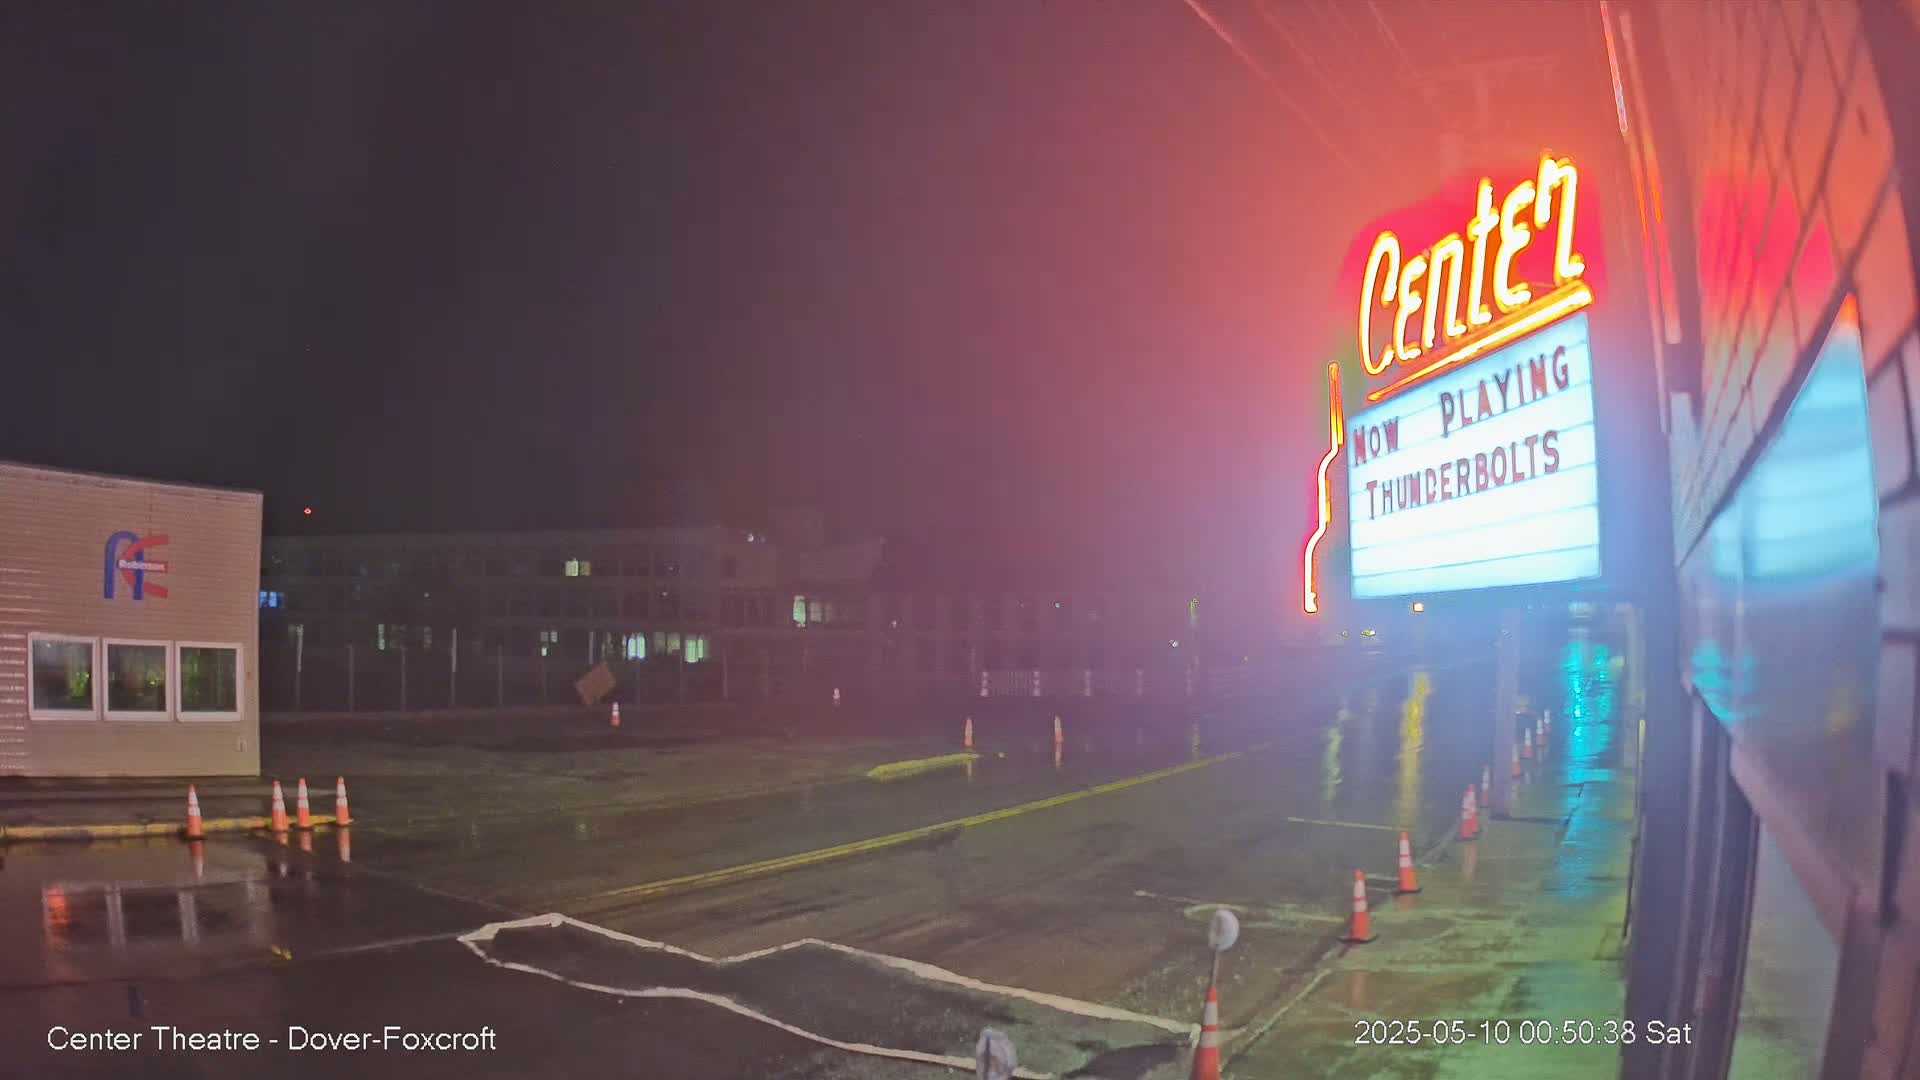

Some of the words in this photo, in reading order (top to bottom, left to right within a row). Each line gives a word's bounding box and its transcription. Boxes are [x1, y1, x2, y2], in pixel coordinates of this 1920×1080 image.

[1359, 151, 1587, 376] Center
[1353, 416, 1400, 467] NOW
[1440, 345, 1570, 438] PLAYING
[1366, 430, 1560, 520] THUNDERBOLTS
